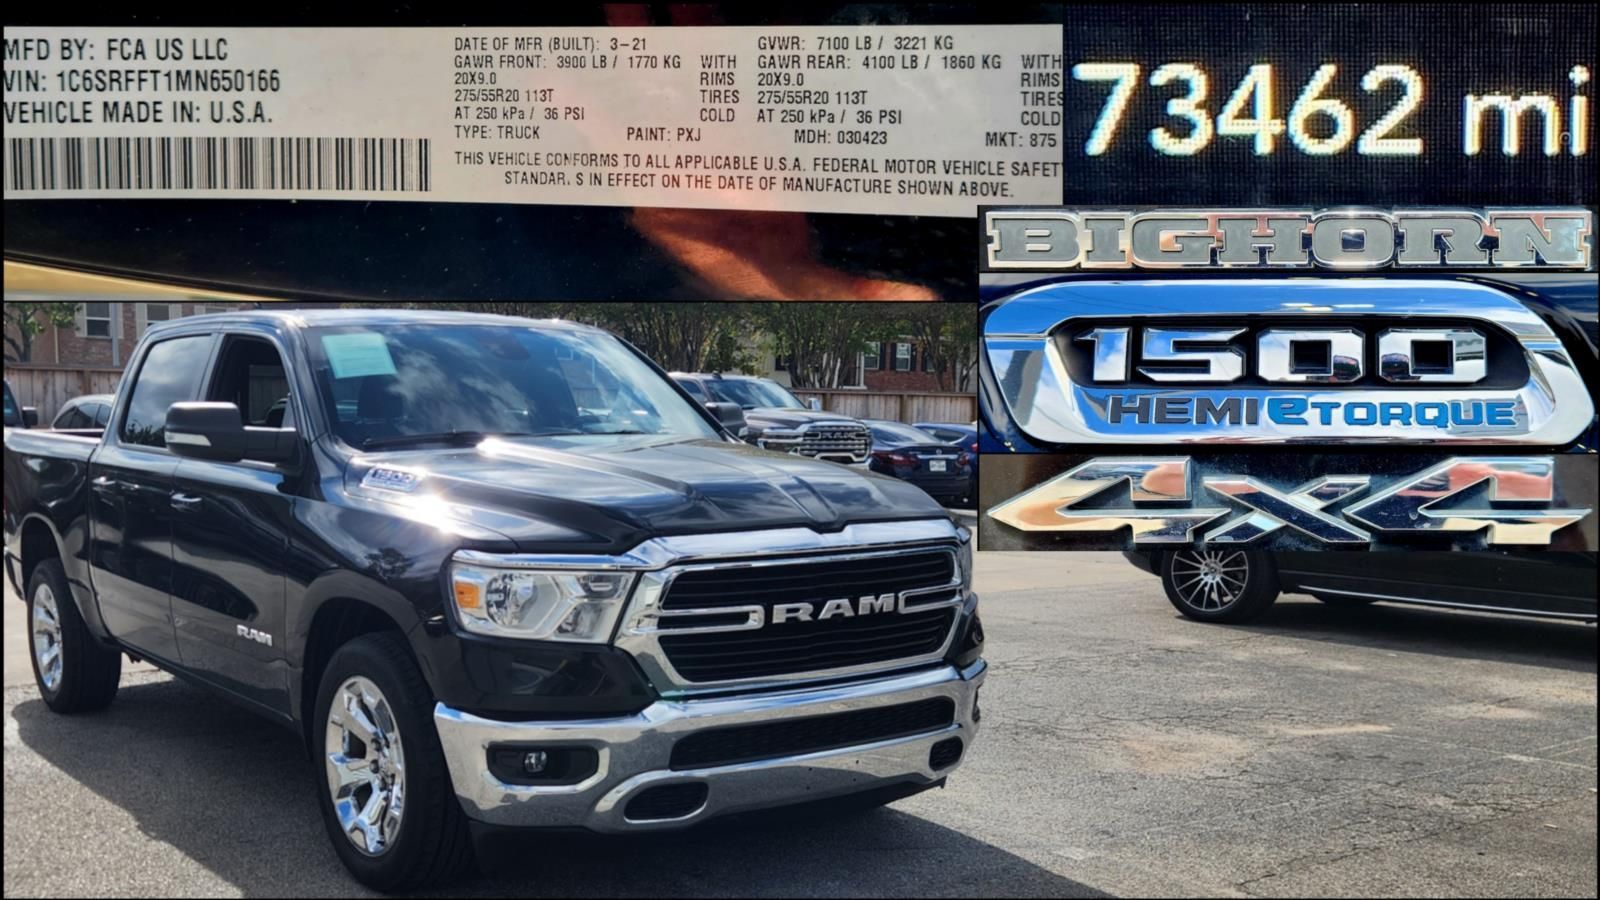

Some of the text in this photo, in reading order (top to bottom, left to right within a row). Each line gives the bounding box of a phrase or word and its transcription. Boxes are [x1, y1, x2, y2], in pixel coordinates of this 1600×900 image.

[3, 38, 229, 60] MFD BY: FCA US LLC
[454, 37, 647, 53] DATE OF MFR (BUILT): 3-21
[757, 36, 954, 50] GVWR: 7100 LB / 3221 KG
[454, 55, 681, 69] GAWR FRONT: 3900 LB / 1770 KG
[700, 55, 737, 69] WITH
[757, 55, 1001, 69] GAWR REAR: 4100 LB / 1860 KG
[1021, 55, 1062, 69] WITH
[3, 69, 281, 92] VIN: 1C6SRFFT1MN650166
[454, 72, 497, 85] 20X9.0
[700, 72, 735, 86] RIMS
[757, 73, 805, 86] 20X9.0
[1020, 73, 1061, 87] RIMS
[454, 89, 555, 102] 275/55R20 113T
[700, 90, 740, 104] TIRES
[757, 91, 868, 105] 275/55R20 113T
[1020, 91, 1063, 106] TIRES
[3, 101, 273, 124] VEHICLE MADE IN: U.S.A.
[454, 107, 585, 120] AT 250 kPa / 36 PSI
[700, 108, 735, 122] COLD
[757, 109, 902, 124] AT 250 kPa / 36 PSI
[1071, 62, 1591, 156] 73462 mi
[1020, 111, 1061, 126] COLD
[454, 125, 540, 140] TYPE: TRUCK
[627, 127, 701, 142] PAINT: PXJ
[794, 130, 888, 145] MDH: 030423
[985, 132, 1057, 148] MKT: 875
[454, 152, 1064, 177] THIS VEHICLE CONFORMS TO ALL APPLICABLE U.S.A. FEDERAL MOTOR VEHICLE SAFET
[589, 173, 602, 186] IN
[607, 173, 656, 188] EFFECT
[661, 174, 681, 188] ON
[686, 175, 712, 189] THE
[718, 176, 754, 190] DATE
[759, 177, 777, 191] OF
[783, 177, 892, 194] MANUFACTURE
[897, 179, 954, 195] SHOWN
[958, 181, 1014, 198] ABOVE.
[986, 209, 1593, 269] BIGHORN
[1074, 326, 1488, 383] 1500
[1105, 394, 1259, 426] HEMI
[772, 592, 895, 625] RAM
[236, 624, 273, 647] RAM
